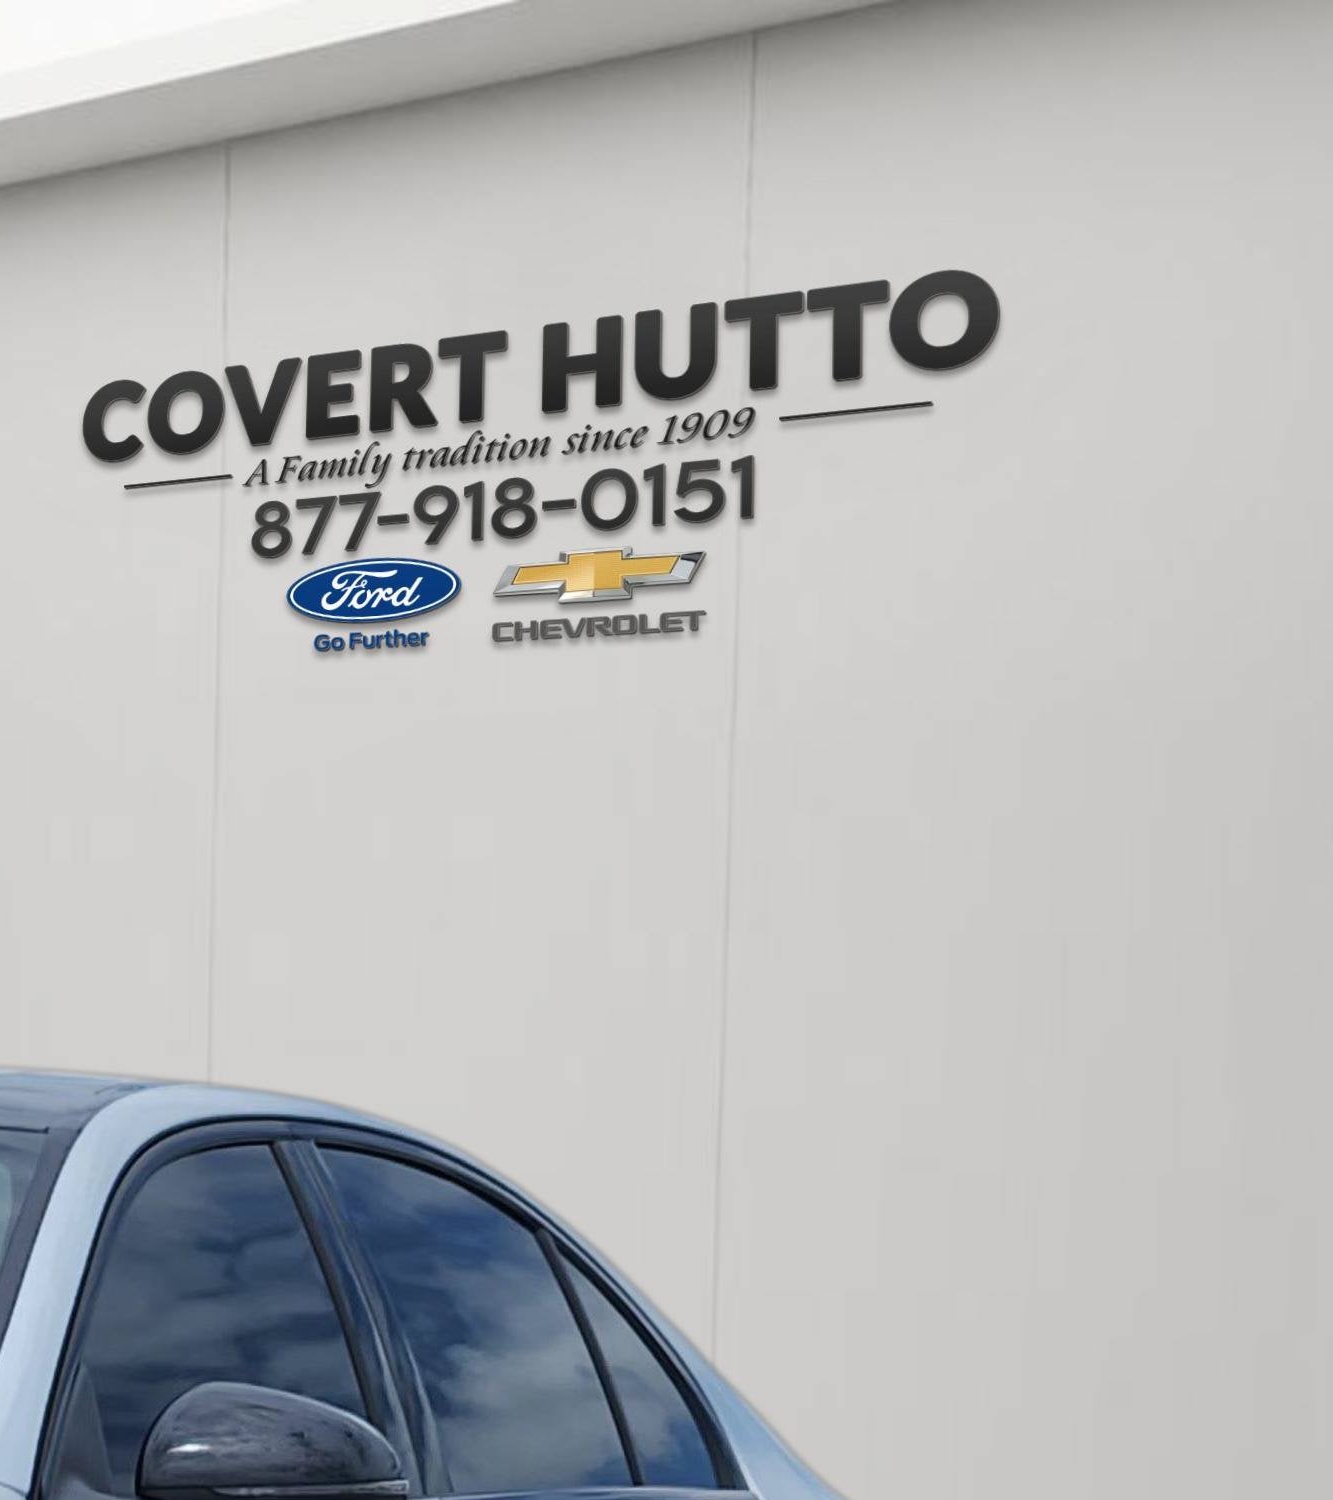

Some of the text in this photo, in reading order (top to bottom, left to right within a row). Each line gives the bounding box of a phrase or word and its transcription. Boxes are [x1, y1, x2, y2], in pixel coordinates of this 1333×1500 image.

[81, 268, 1002, 464] COVERT HUTTO
[242, 406, 757, 489] A Family tradition since 1909
[250, 454, 756, 560] 877-918-0151
[321, 567, 421, 612] Ford
[313, 628, 430, 653] Go Further
[491, 609, 707, 644] CHEVROLET
